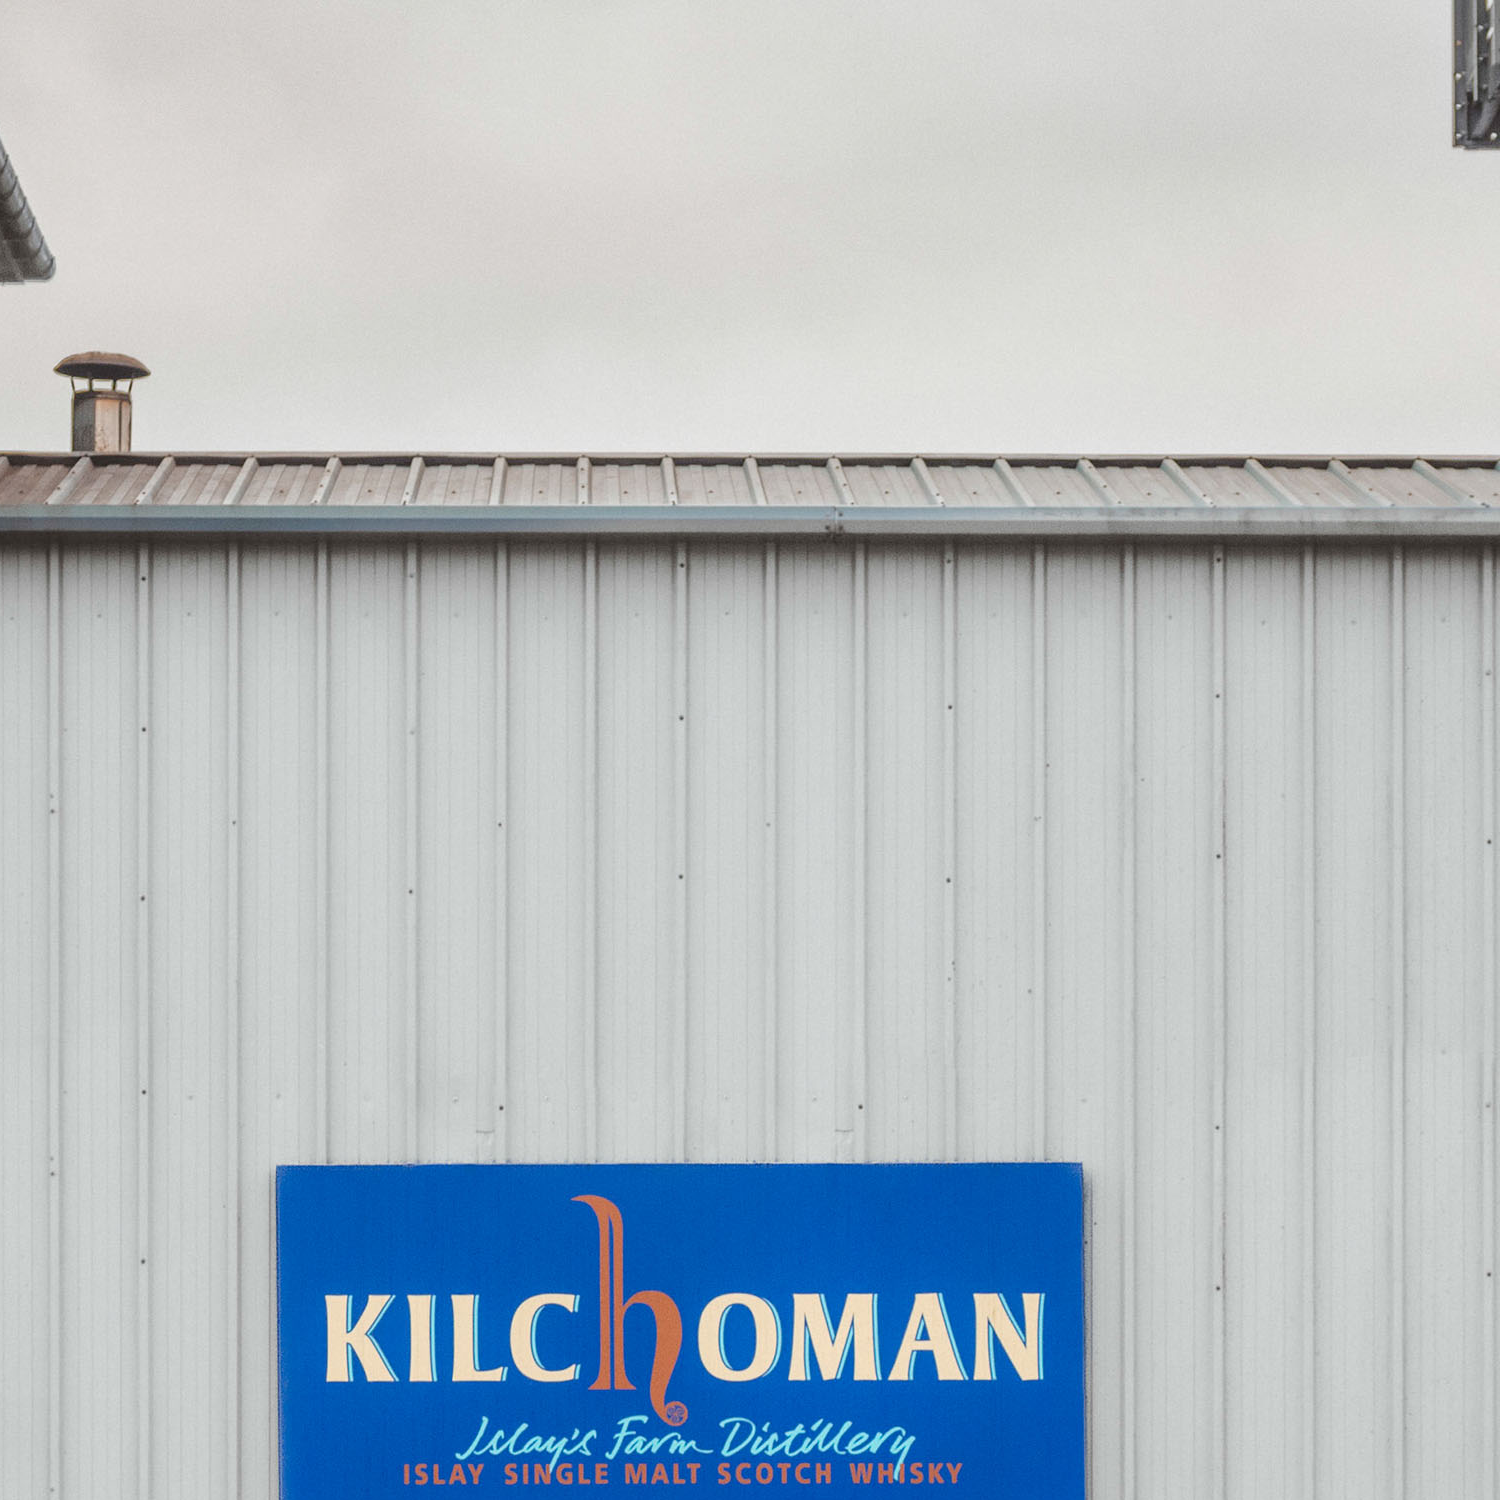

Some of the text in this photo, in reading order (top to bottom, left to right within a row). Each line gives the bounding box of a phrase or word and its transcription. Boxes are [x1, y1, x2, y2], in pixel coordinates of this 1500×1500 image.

[455, 1415, 916, 1481] Islay's Farm Distillery
[403, 1463, 963, 1485] ISLAY SINGLE MALT SCOTCH WHISKY
